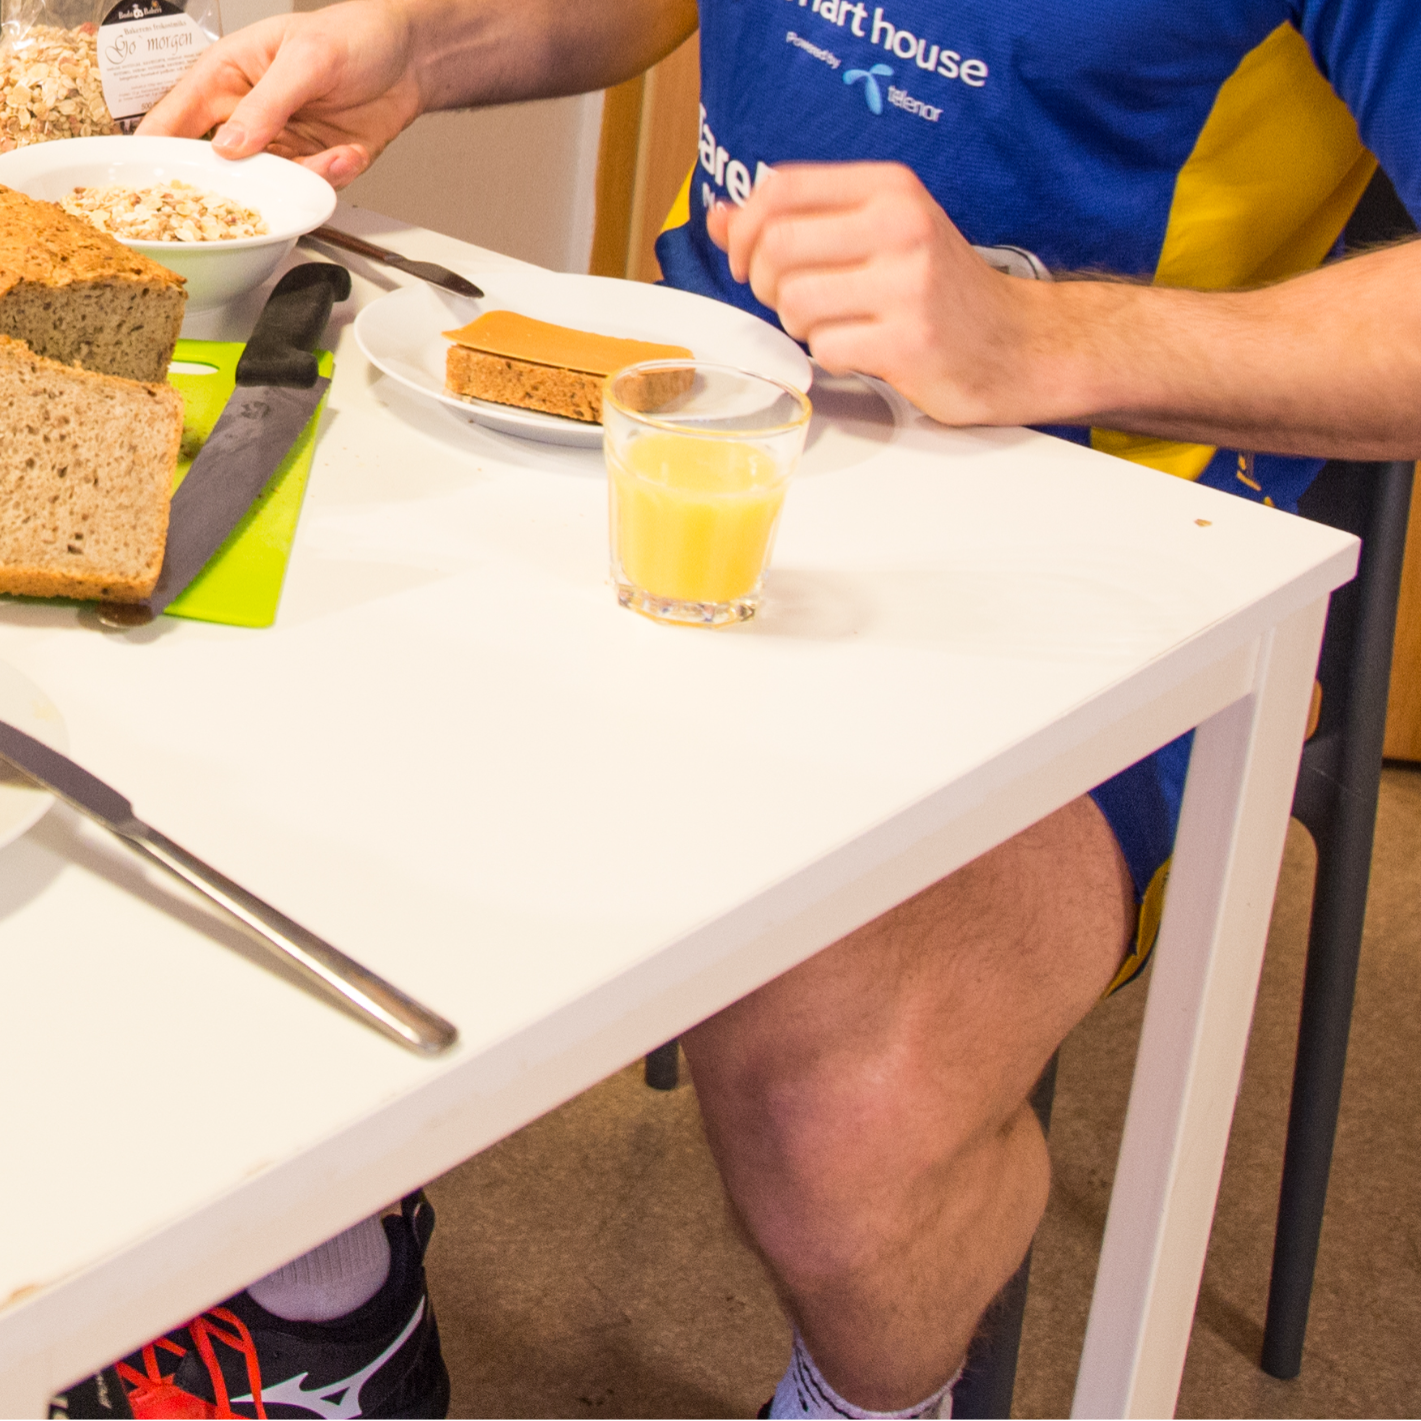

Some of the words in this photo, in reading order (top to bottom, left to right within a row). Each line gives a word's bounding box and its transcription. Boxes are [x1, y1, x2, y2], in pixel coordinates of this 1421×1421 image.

[147, 32, 192, 56] morgen
[870, 7, 989, 87] house
[888, 85, 944, 122] telenor
